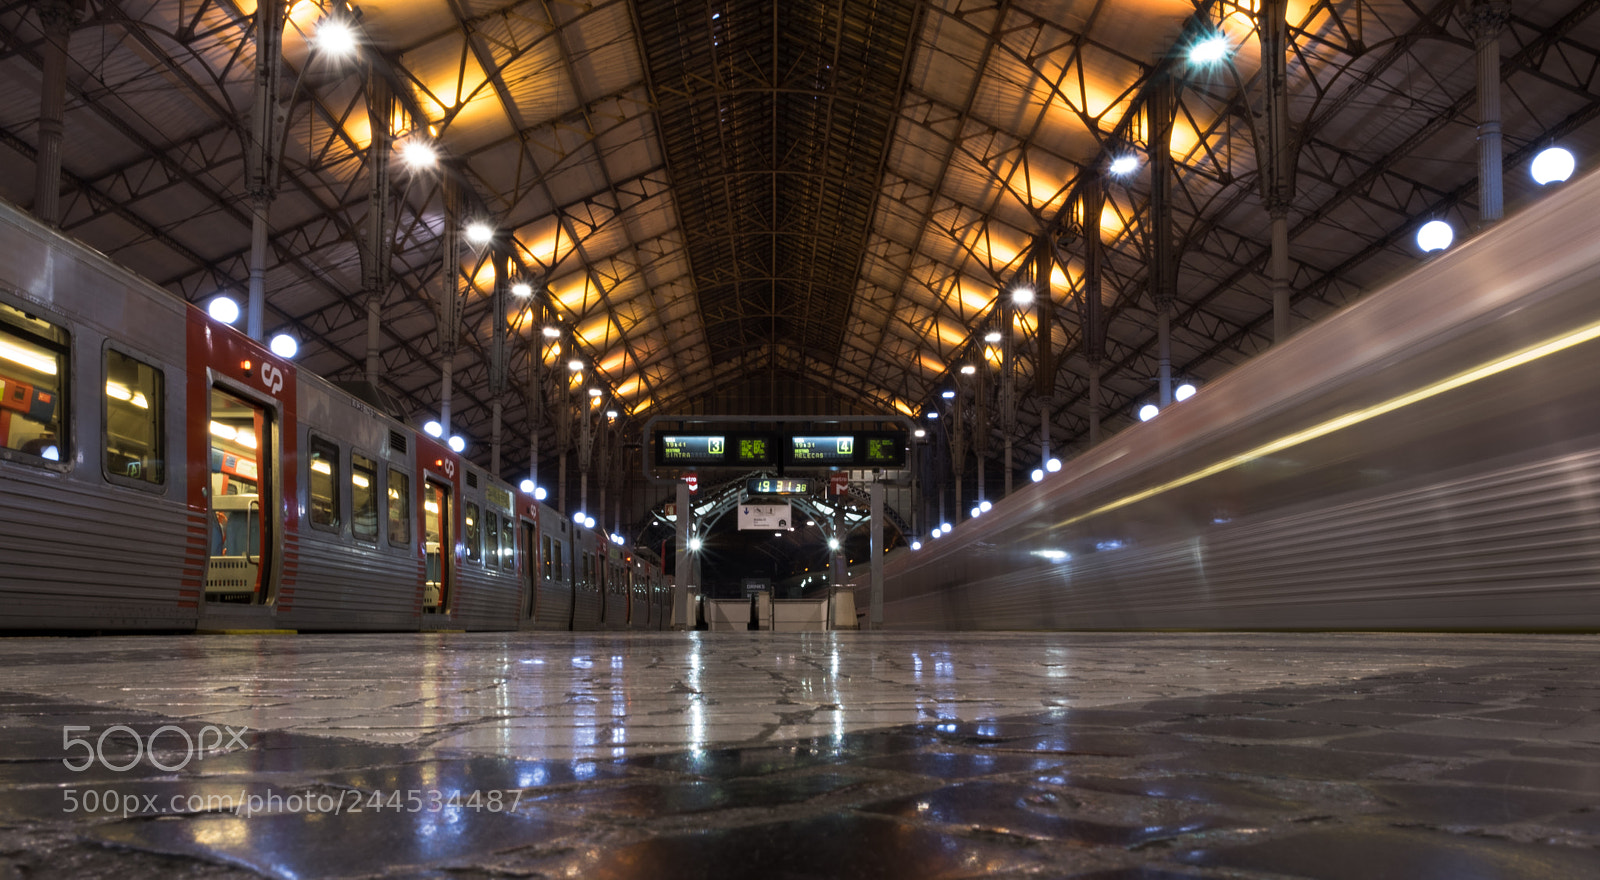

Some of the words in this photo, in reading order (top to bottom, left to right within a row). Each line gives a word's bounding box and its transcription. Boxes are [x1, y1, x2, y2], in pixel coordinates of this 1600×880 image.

[261, 362, 283, 394] CP
[840, 439, 849, 452] 4
[758, 480, 770, 492] 19
[776, 480, 792, 492] 31
